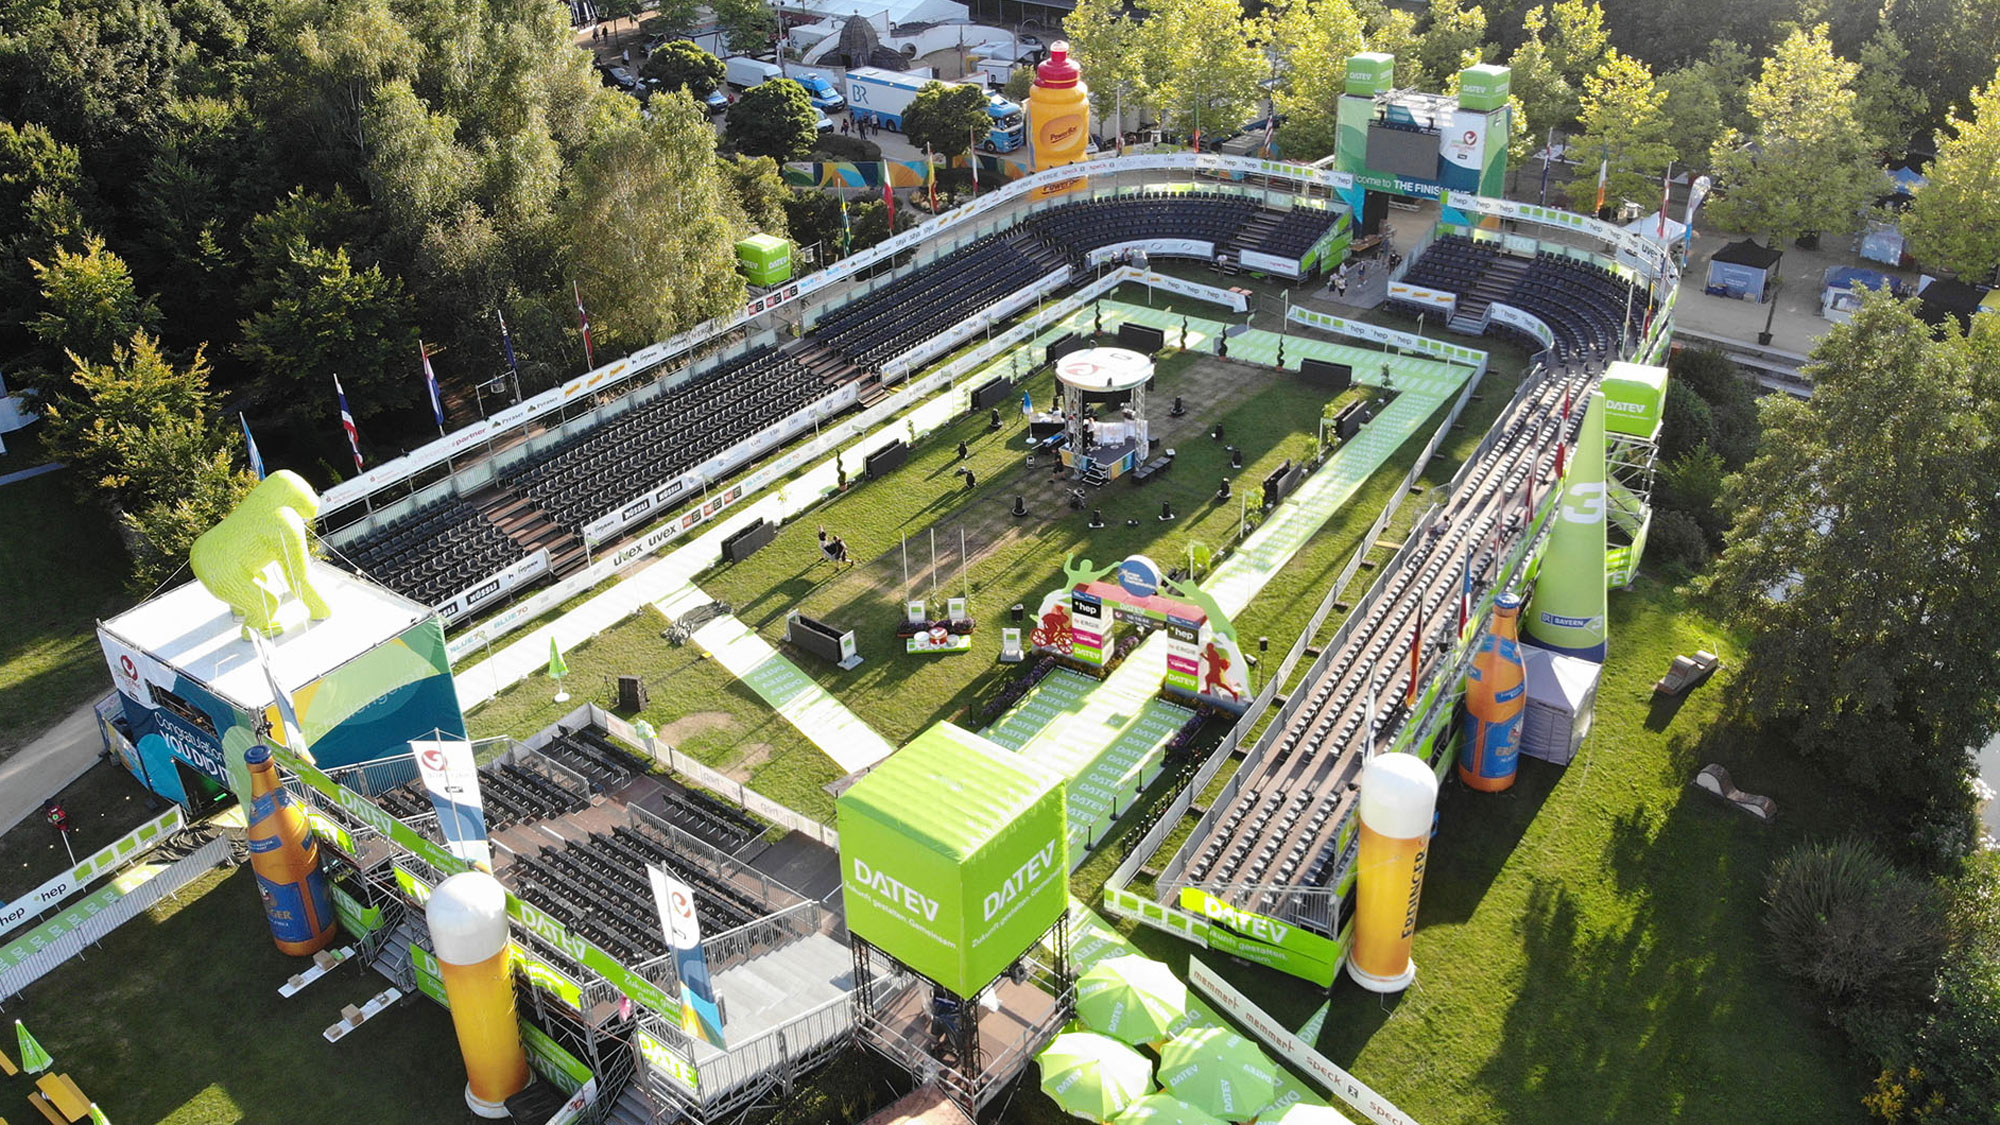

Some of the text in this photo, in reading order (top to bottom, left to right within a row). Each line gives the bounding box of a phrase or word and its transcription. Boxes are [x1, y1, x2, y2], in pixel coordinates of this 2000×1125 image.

[851, 84, 869, 105] BR
[1394, 180, 1413, 191] THE
[1606, 399, 1646, 413] DATEV
[1562, 482, 1605, 524] 3
[647, 523, 678, 548] uvex
[1079, 601, 1097, 616] hep
[1554, 617, 1584, 627] BAYERN
[1175, 627, 1194, 642] hep
[160, 729, 192, 760] YOU
[191, 748, 219, 776] DID
[338, 788, 393, 835] DATEV
[41, 882, 67, 902] hep
[854, 857, 940, 922] DATEV
[983, 838, 1057, 922] DATEV
[0, 906, 25, 927] hep
[1204, 896, 1289, 944] DATEV
[1193, 970, 1240, 1011] memmert
[1108, 1001, 1125, 1033] DATEV
[1245, 1011, 1295, 1053] memmert
[1056, 1068, 1083, 1095] DATEV
[1170, 1064, 1199, 1087] DATEV
[1306, 1055, 1343, 1087] speck
[1220, 1079, 1234, 1113] DATEV
